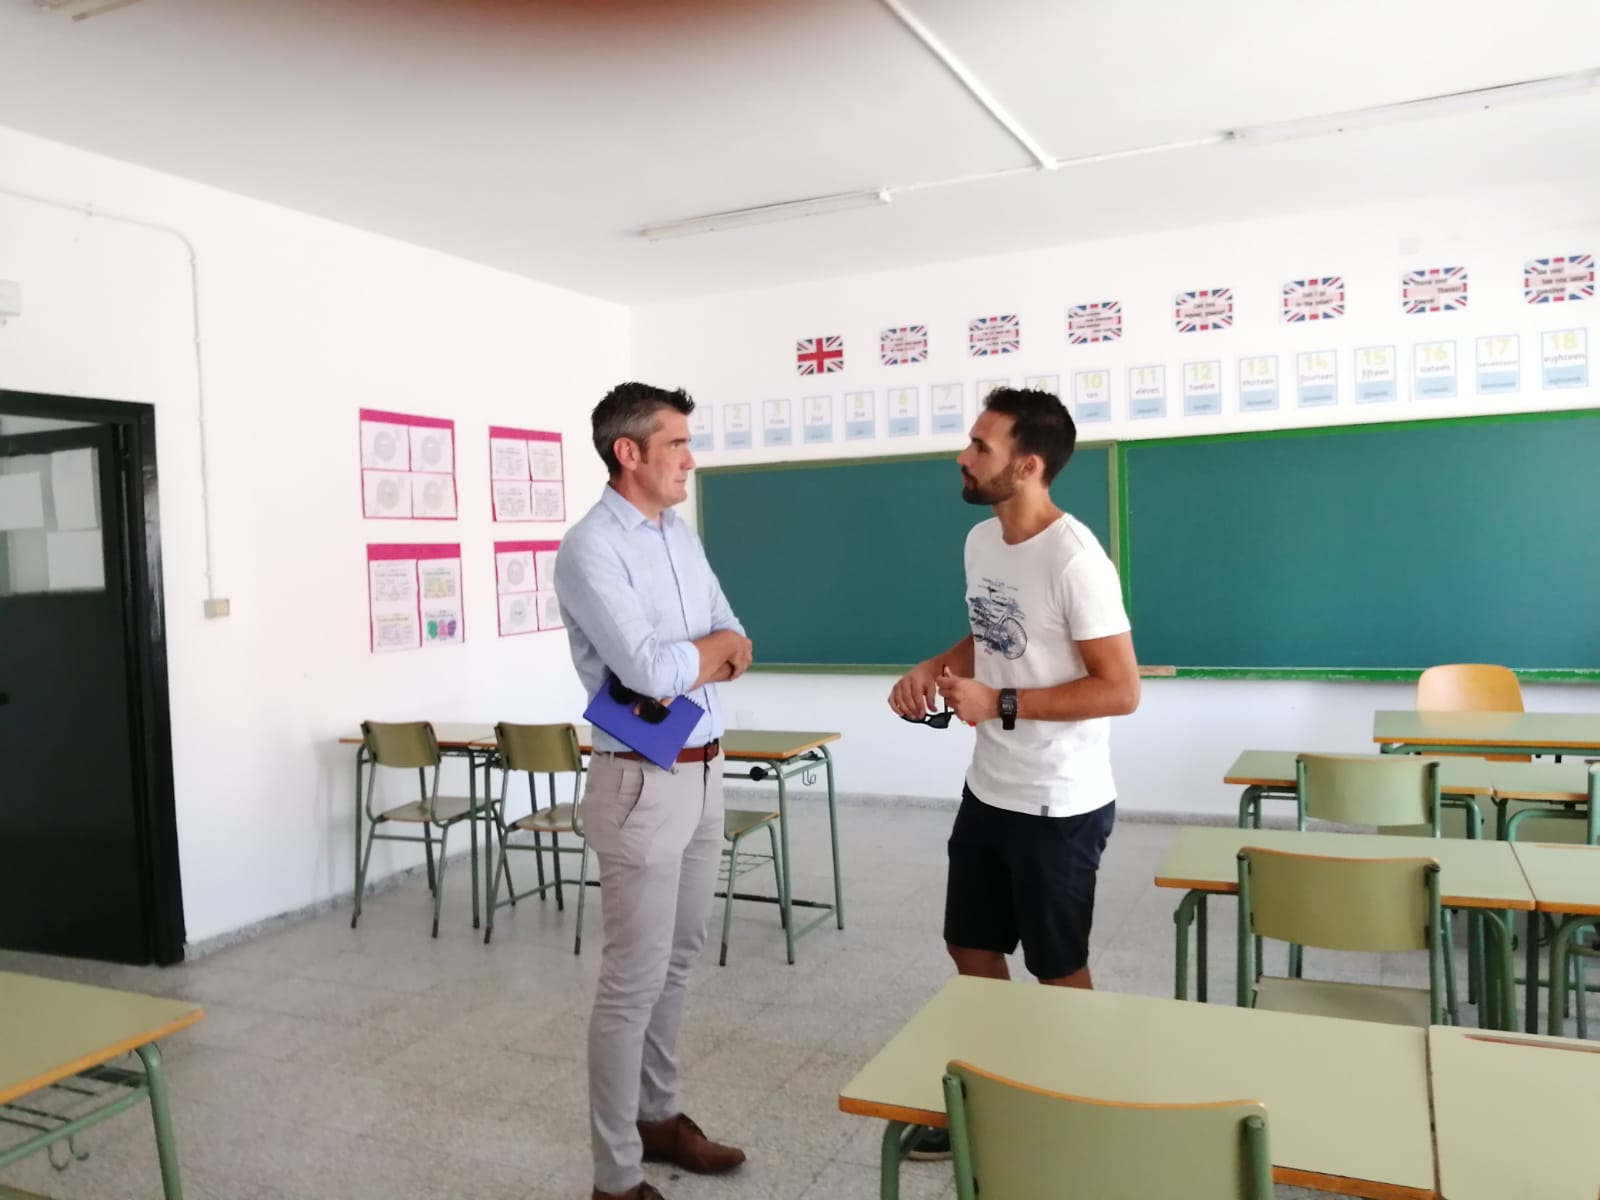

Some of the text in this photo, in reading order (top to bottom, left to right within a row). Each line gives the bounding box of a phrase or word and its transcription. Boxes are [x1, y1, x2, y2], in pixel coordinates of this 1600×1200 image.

[1485, 338, 1510, 357] 17
[1551, 333, 1577, 351] 18
[1362, 349, 1386, 366] 15
[1423, 344, 1448, 362] 16
[1247, 359, 1270, 376] 13
[1305, 354, 1329, 371] 14
[1082, 373, 1103, 389] 10
[1137, 367, 1157, 385] 11
[1191, 363, 1213, 381] 12
